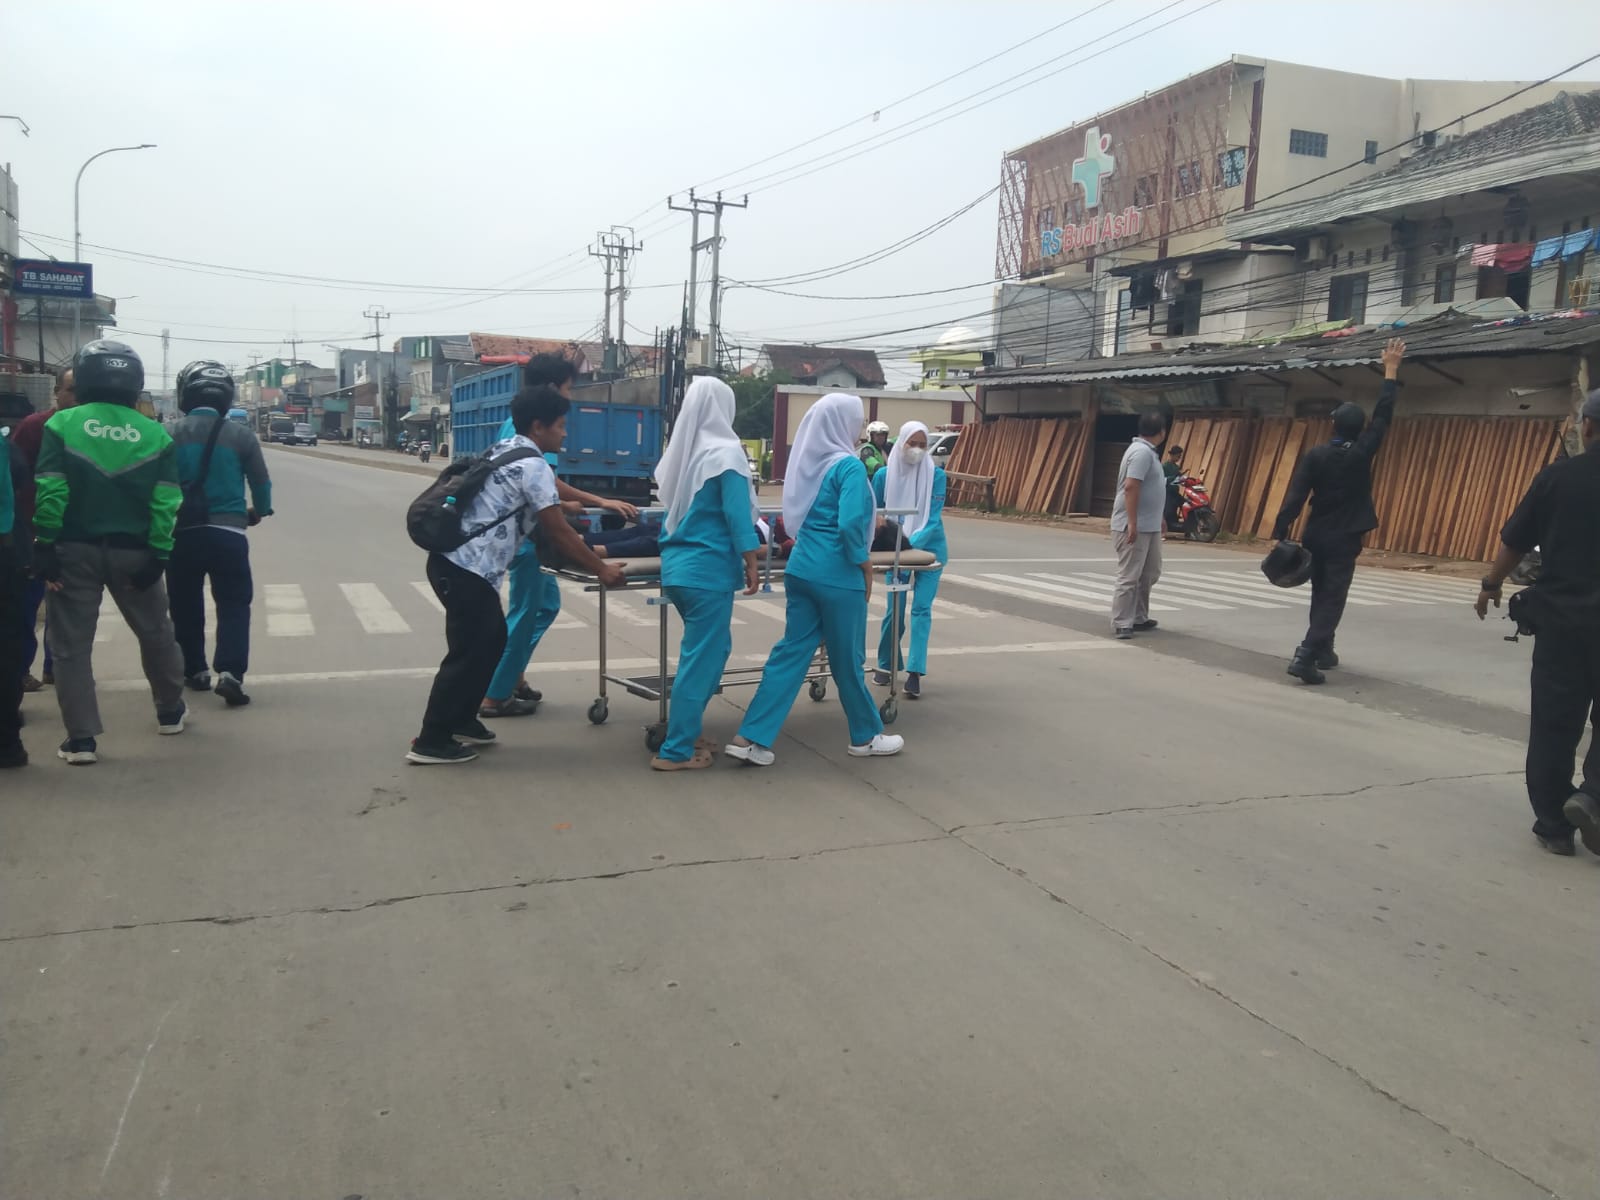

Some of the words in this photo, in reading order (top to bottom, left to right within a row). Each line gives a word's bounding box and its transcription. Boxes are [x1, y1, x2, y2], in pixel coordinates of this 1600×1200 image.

[1041, 228, 1062, 257] RS
[1063, 217, 1098, 251] Budi
[1101, 206, 1141, 242] Asih
[22, 271, 37, 280] TB
[39, 272, 85, 283] SAHABAT
[83, 419, 141, 443] Grab
